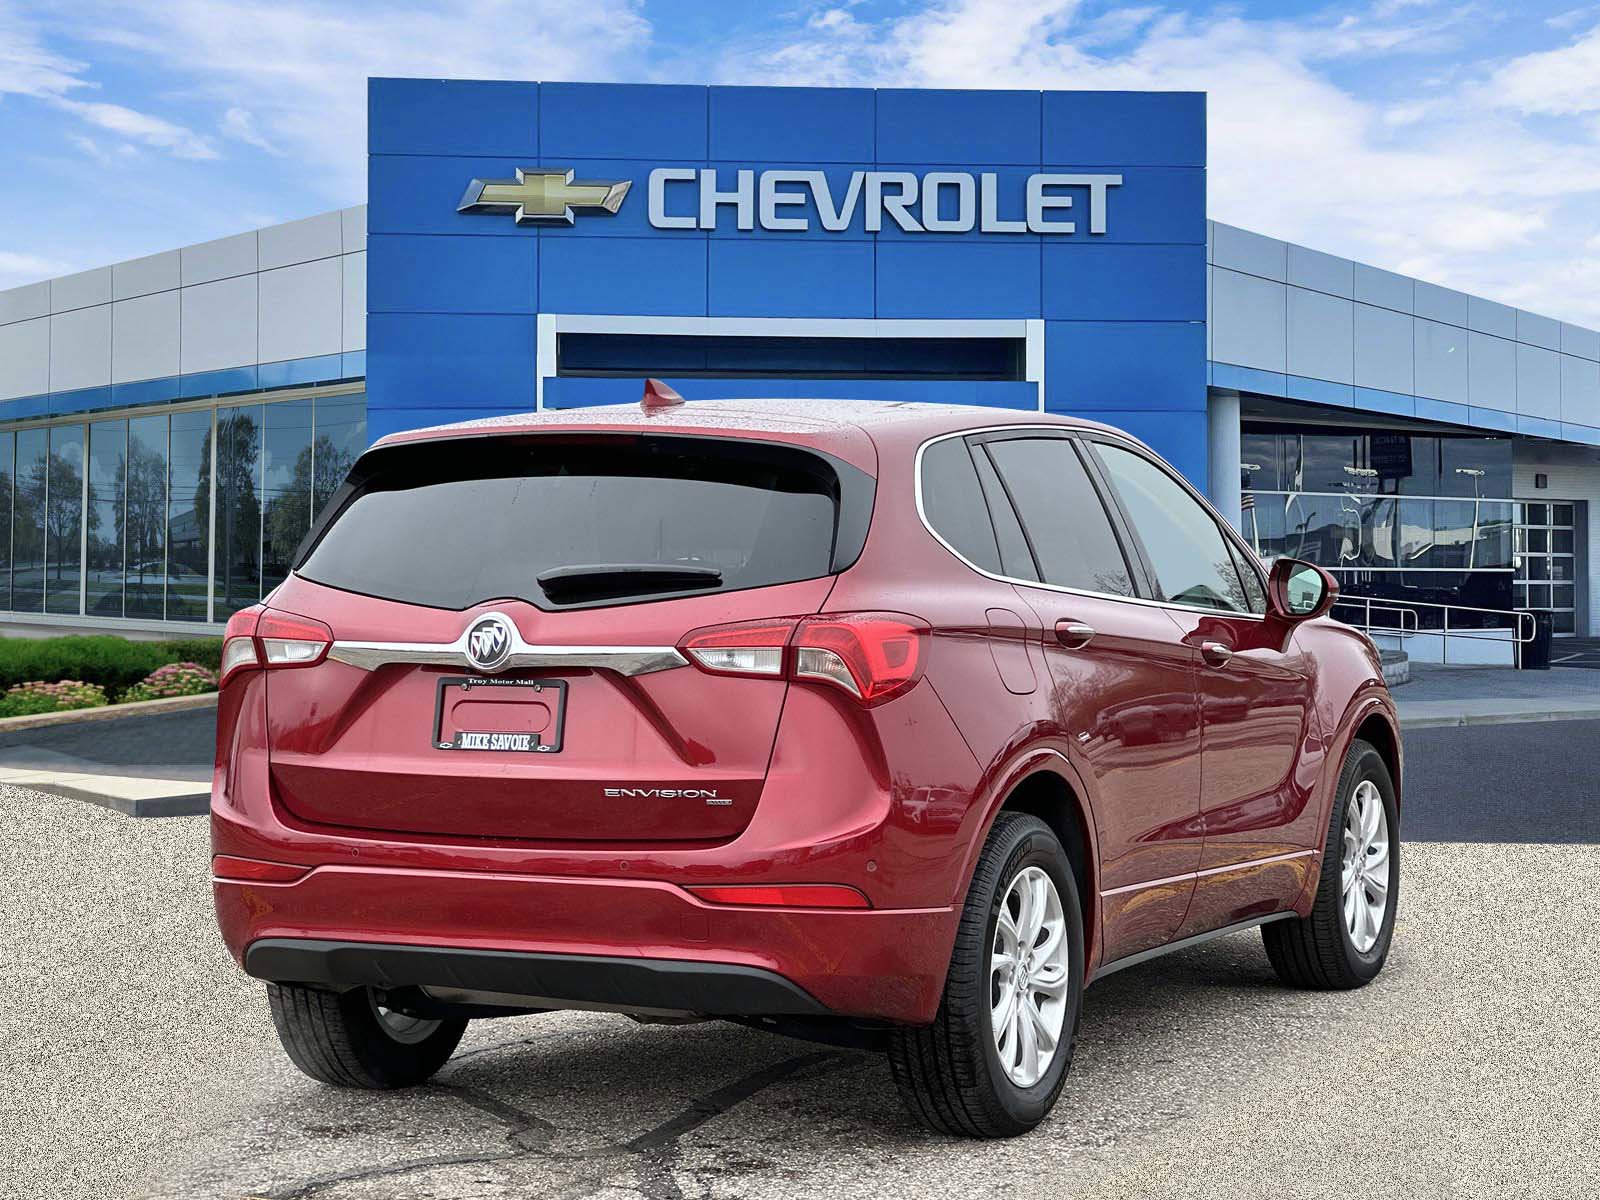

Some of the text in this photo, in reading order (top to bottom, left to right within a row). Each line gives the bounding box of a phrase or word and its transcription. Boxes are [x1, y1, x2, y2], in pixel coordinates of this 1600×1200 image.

[648, 168, 1123, 234] CHEVROLET
[468, 677, 487, 686] Troy
[461, 733, 530, 751] MIKE SAVOIE
[603, 788, 717, 798] ENVISION
